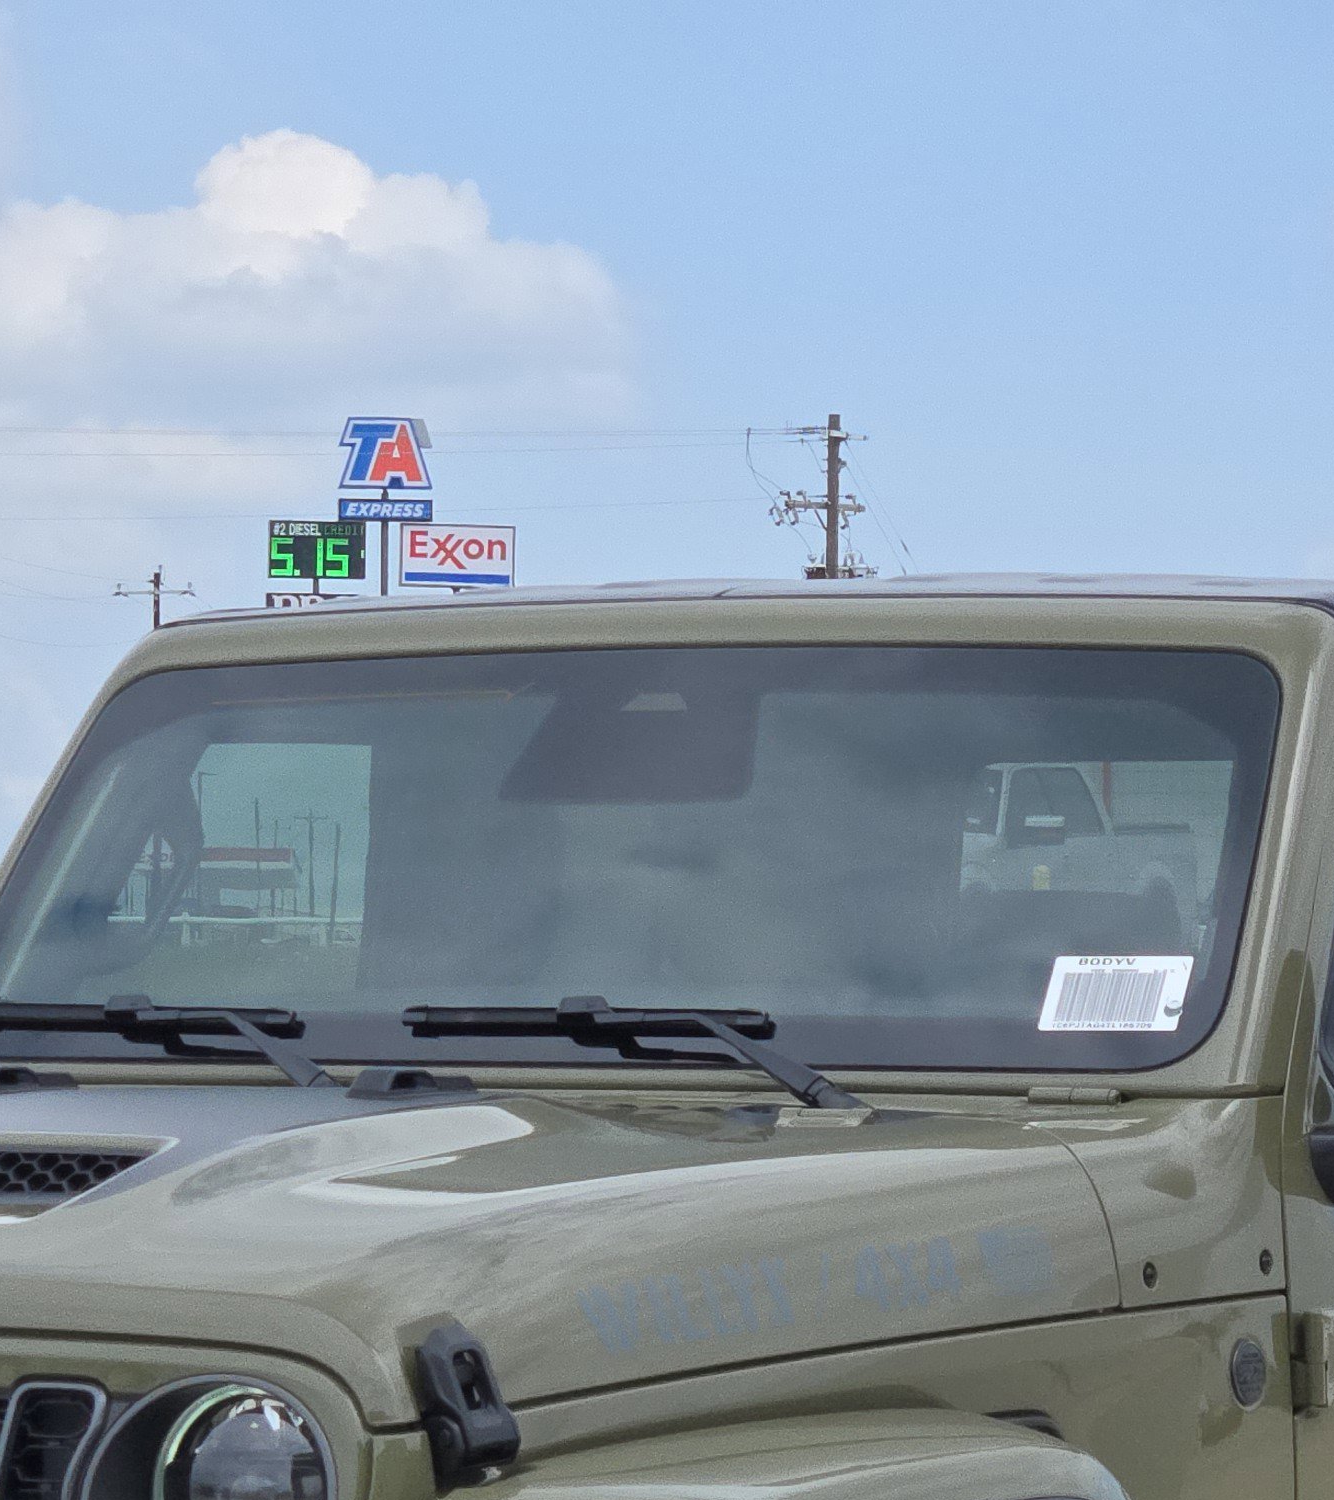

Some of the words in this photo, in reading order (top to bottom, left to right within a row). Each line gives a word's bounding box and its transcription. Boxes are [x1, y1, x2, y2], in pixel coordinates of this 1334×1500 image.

[348, 423, 423, 482] TA
[346, 502, 424, 518] EXPRESS
[289, 523, 321, 536] DIESEL
[409, 530, 507, 570] Exxon
[1078, 958, 1137, 966] BODYV
